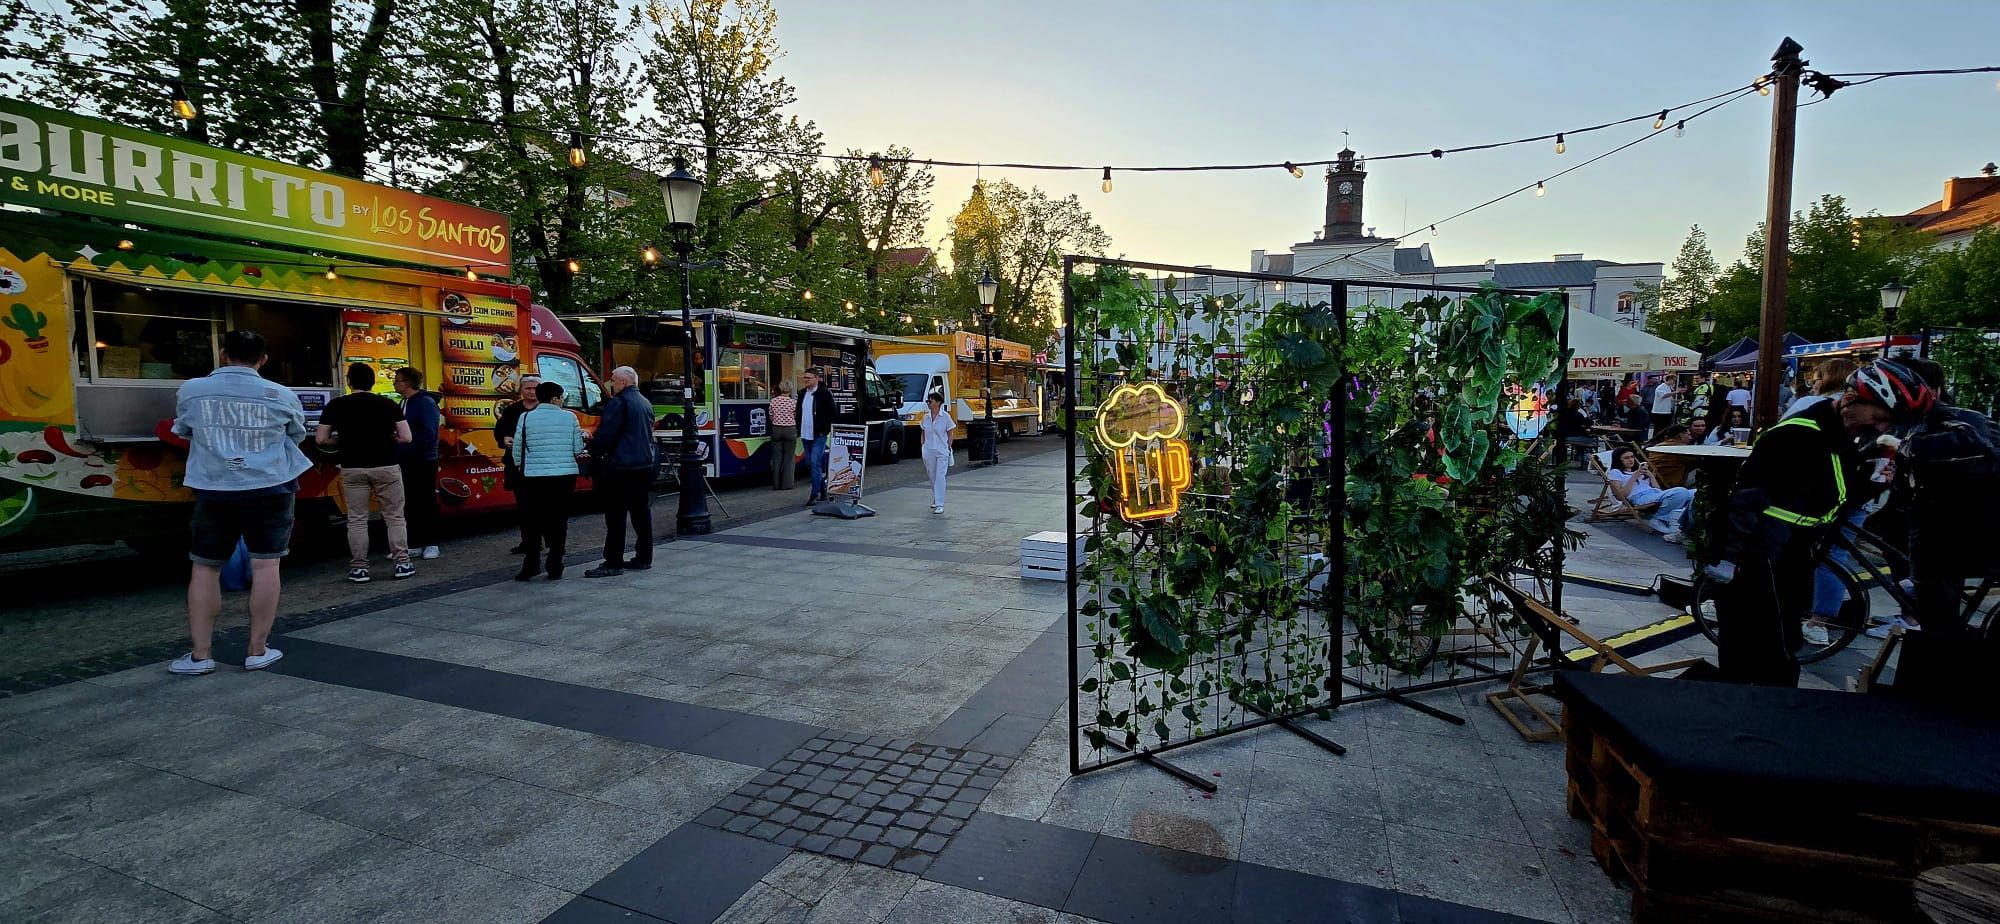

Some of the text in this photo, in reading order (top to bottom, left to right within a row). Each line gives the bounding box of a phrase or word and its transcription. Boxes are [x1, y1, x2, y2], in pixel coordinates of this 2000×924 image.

[0, 112, 345, 228] BURRITO
[352, 205, 369, 216] BY
[11, 176, 115, 206] & MORE
[473, 306, 515, 318] CON CARNE
[449, 339, 484, 350] POLLO
[1573, 357, 1621, 368] TYSKIE
[1664, 357, 1688, 366] TYSKIE
[452, 368, 485, 376] TAJSKI
[453, 376, 485, 386] WRAP
[200, 399, 268, 427] WASTED
[450, 406, 491, 417] MASALA
[202, 426, 265, 453] YOUTH
[834, 437, 864, 447] Churros
